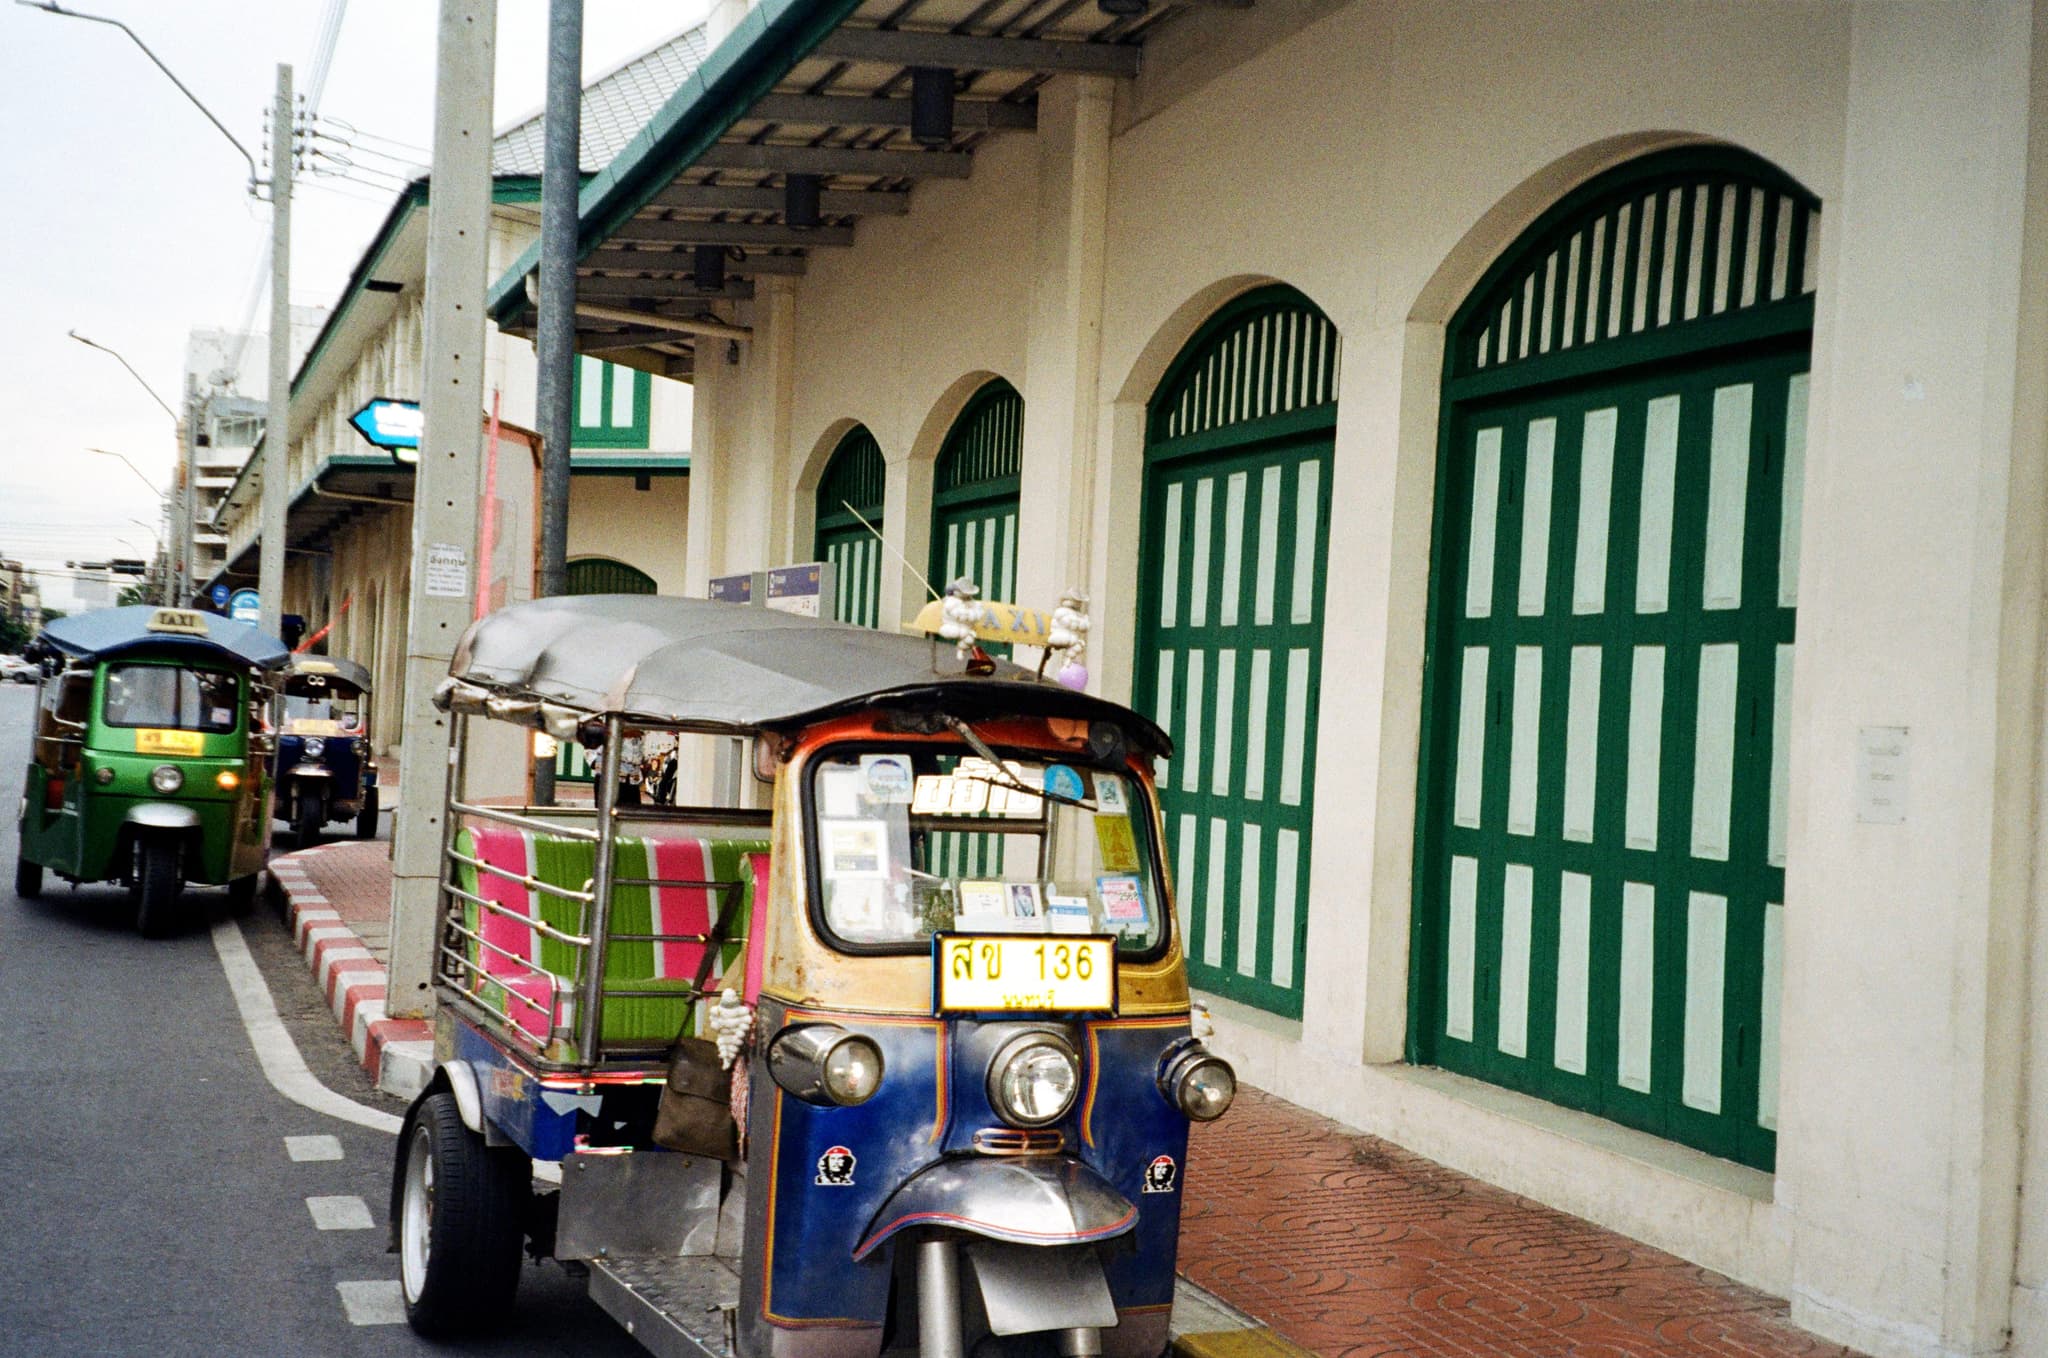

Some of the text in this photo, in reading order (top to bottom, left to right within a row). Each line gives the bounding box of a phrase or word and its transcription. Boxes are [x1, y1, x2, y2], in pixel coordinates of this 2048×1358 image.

[159, 613, 194, 627] TAXI
[983, 608, 1044, 634] AXI
[952, 940, 1093, 980] สข 136
[1002, 989, 1055, 1010] นนทบรี
